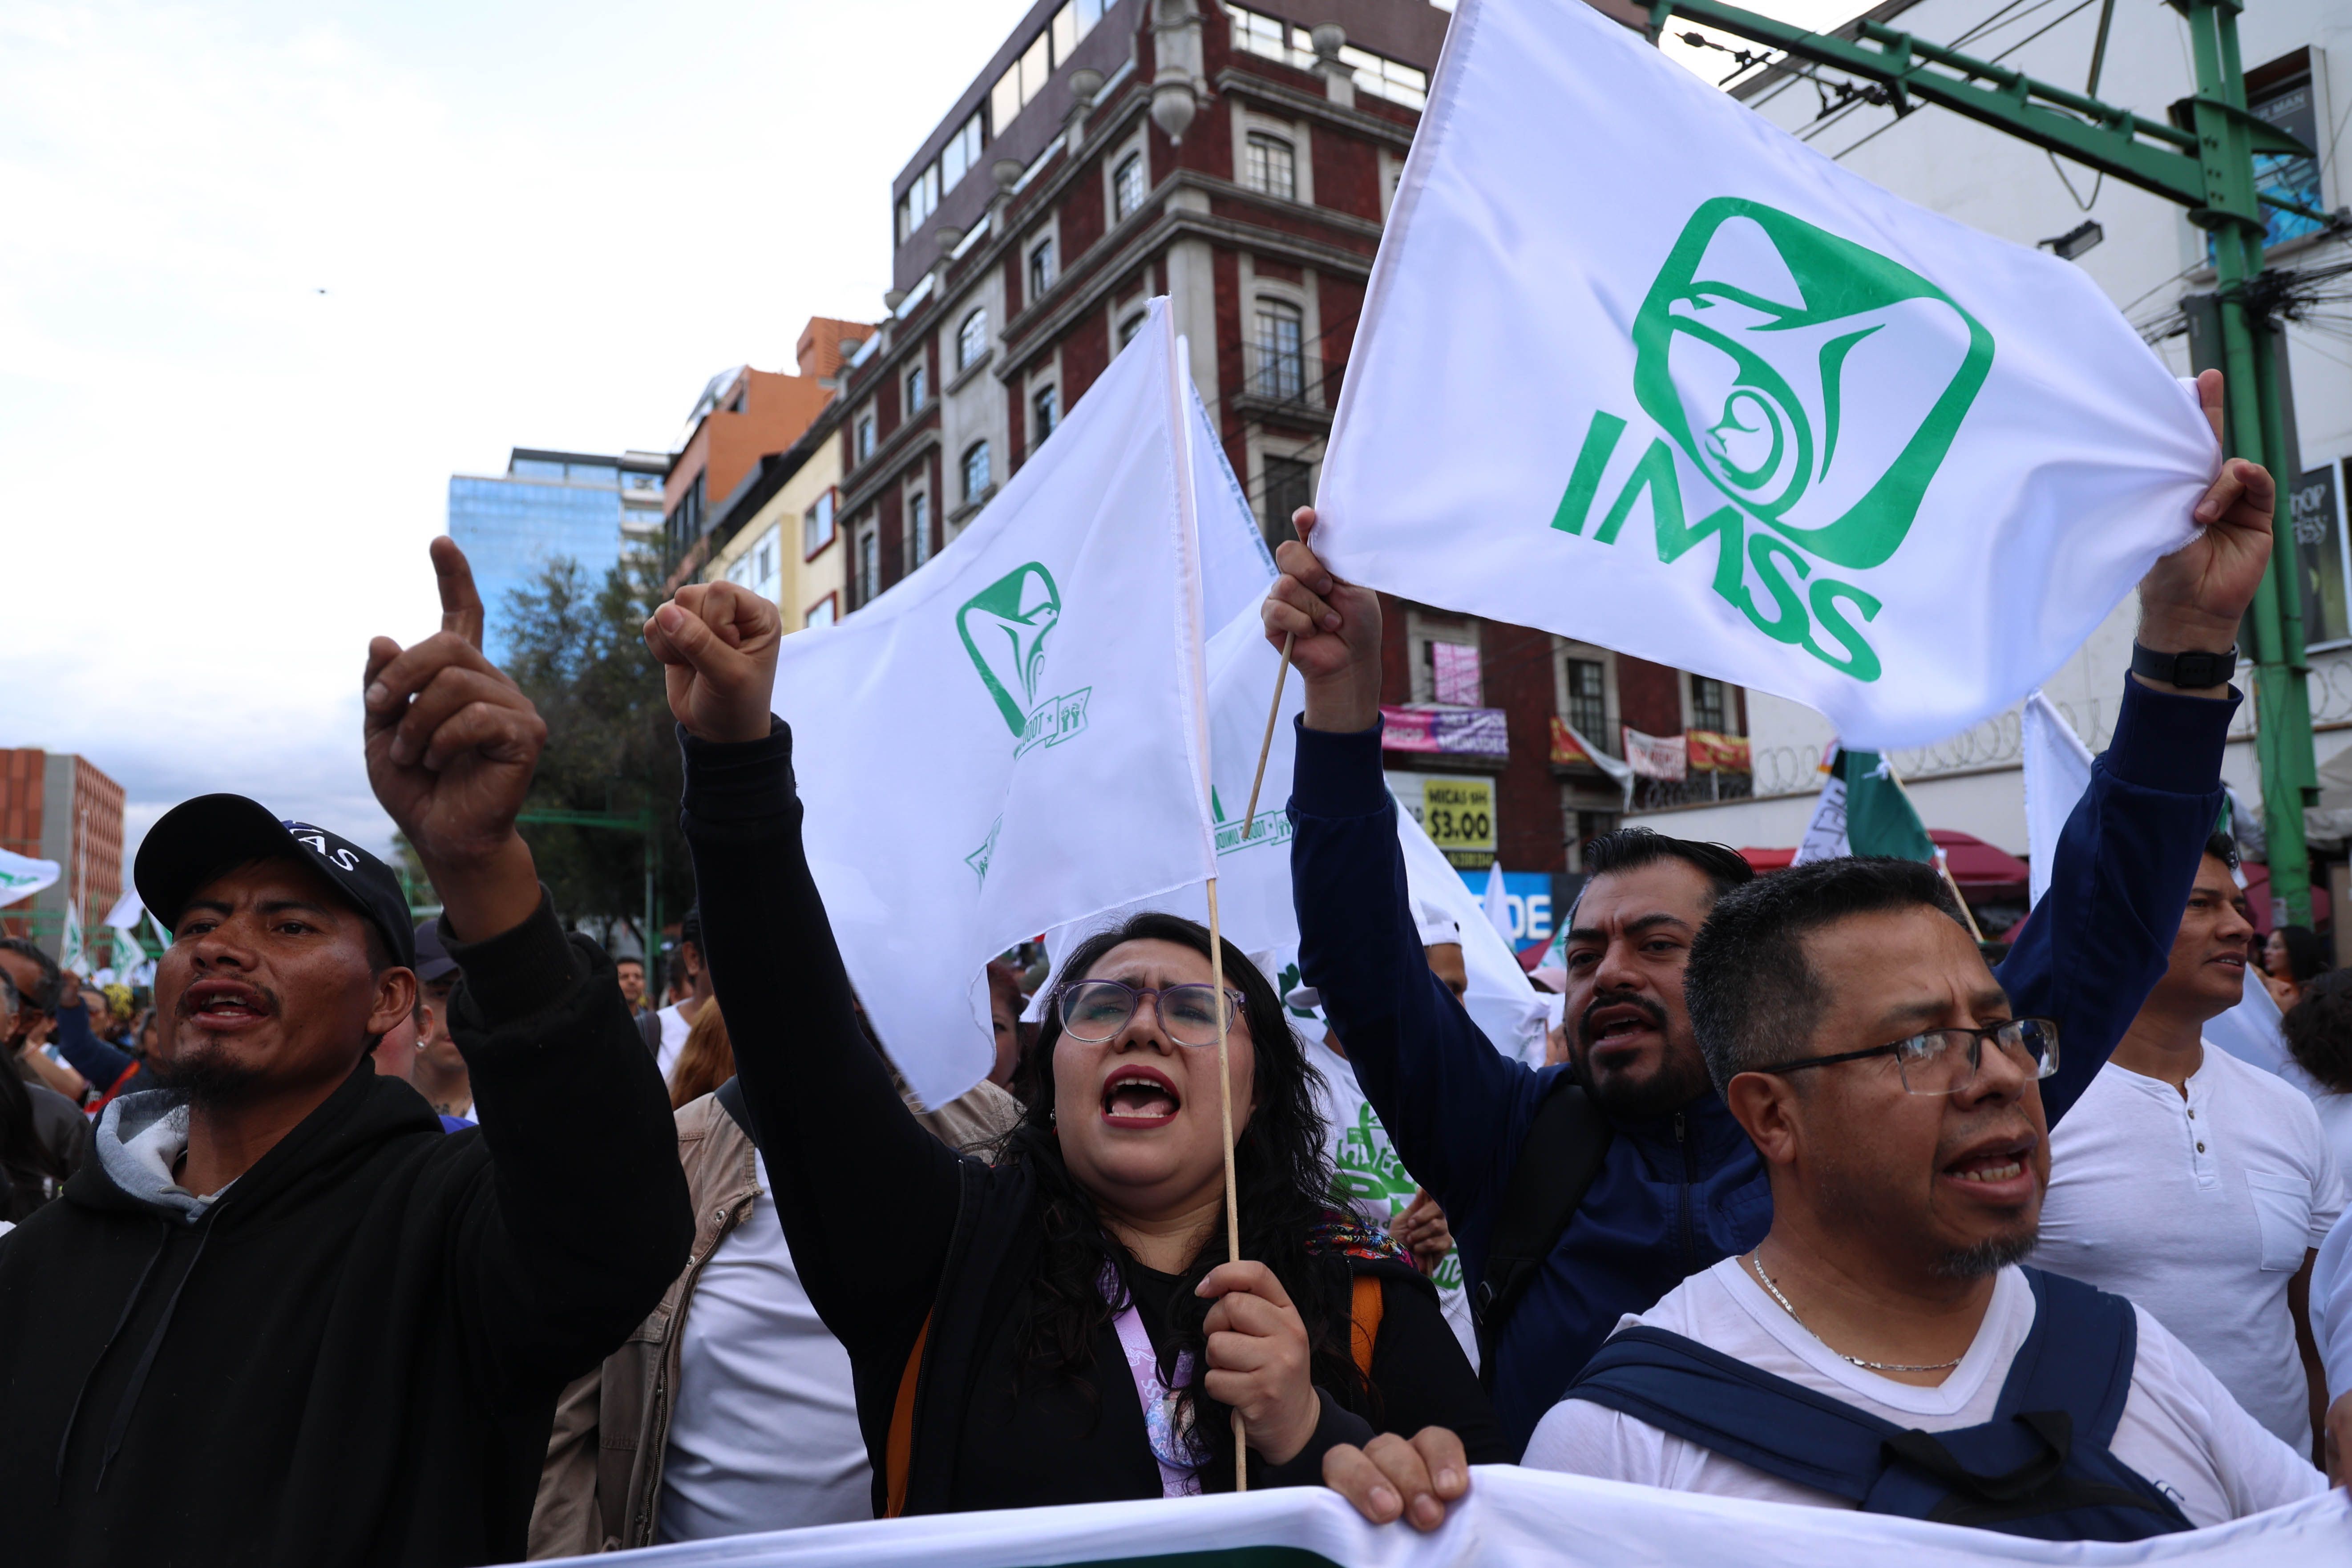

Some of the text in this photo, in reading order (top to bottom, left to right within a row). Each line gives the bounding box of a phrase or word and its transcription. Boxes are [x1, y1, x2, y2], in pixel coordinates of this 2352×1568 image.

[1550, 409, 1883, 683] IMSS
[1431, 808, 1489, 841] $3.00
[290, 827, 360, 871] AS
